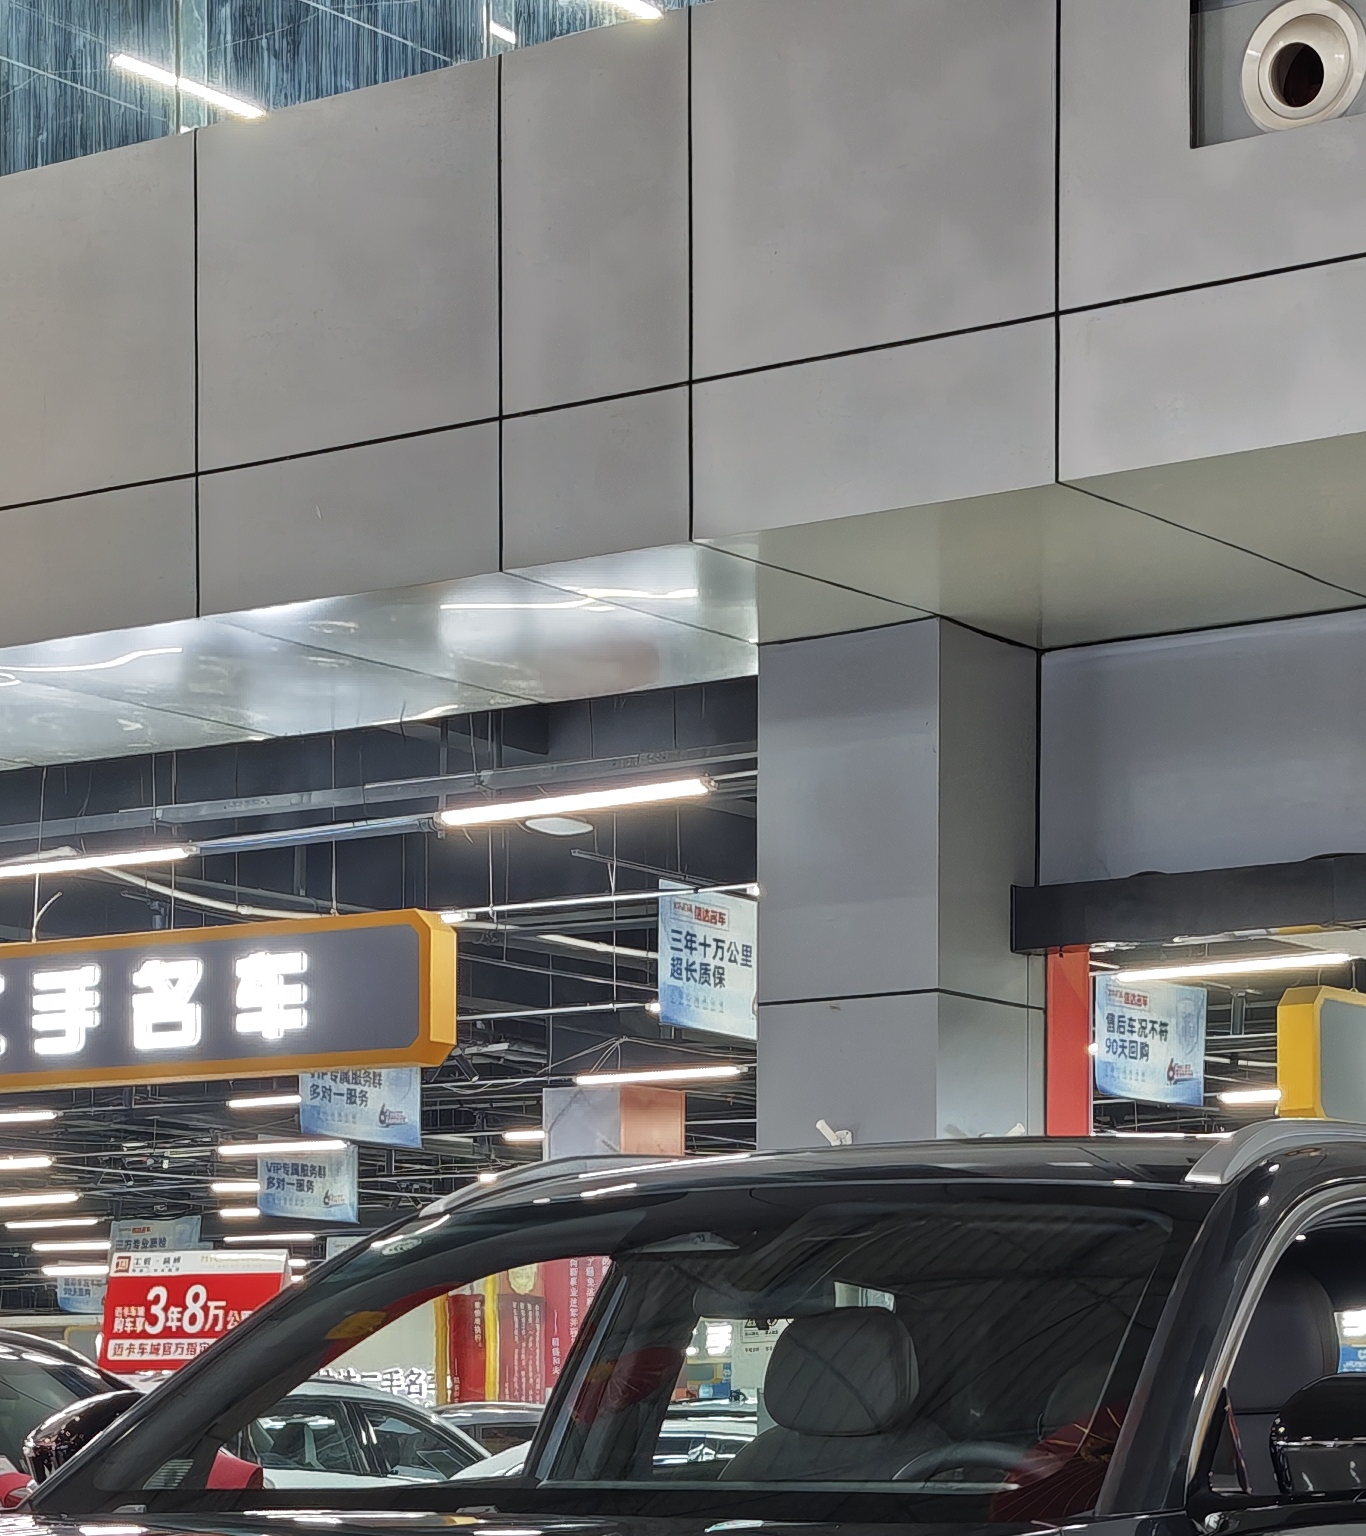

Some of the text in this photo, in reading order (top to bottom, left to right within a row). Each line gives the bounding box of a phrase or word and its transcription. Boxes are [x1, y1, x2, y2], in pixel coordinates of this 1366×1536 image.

[670, 928, 753, 968] 三年十万公里
[669, 956, 726, 989] 超长质保
[1105, 1012, 1170, 1043] 售后车况不符
[1105, 1037, 1151, 1063] 90天回购
[309, 1084, 369, 1108] 多对一服务
[265, 1176, 315, 1194] 多对一服务
